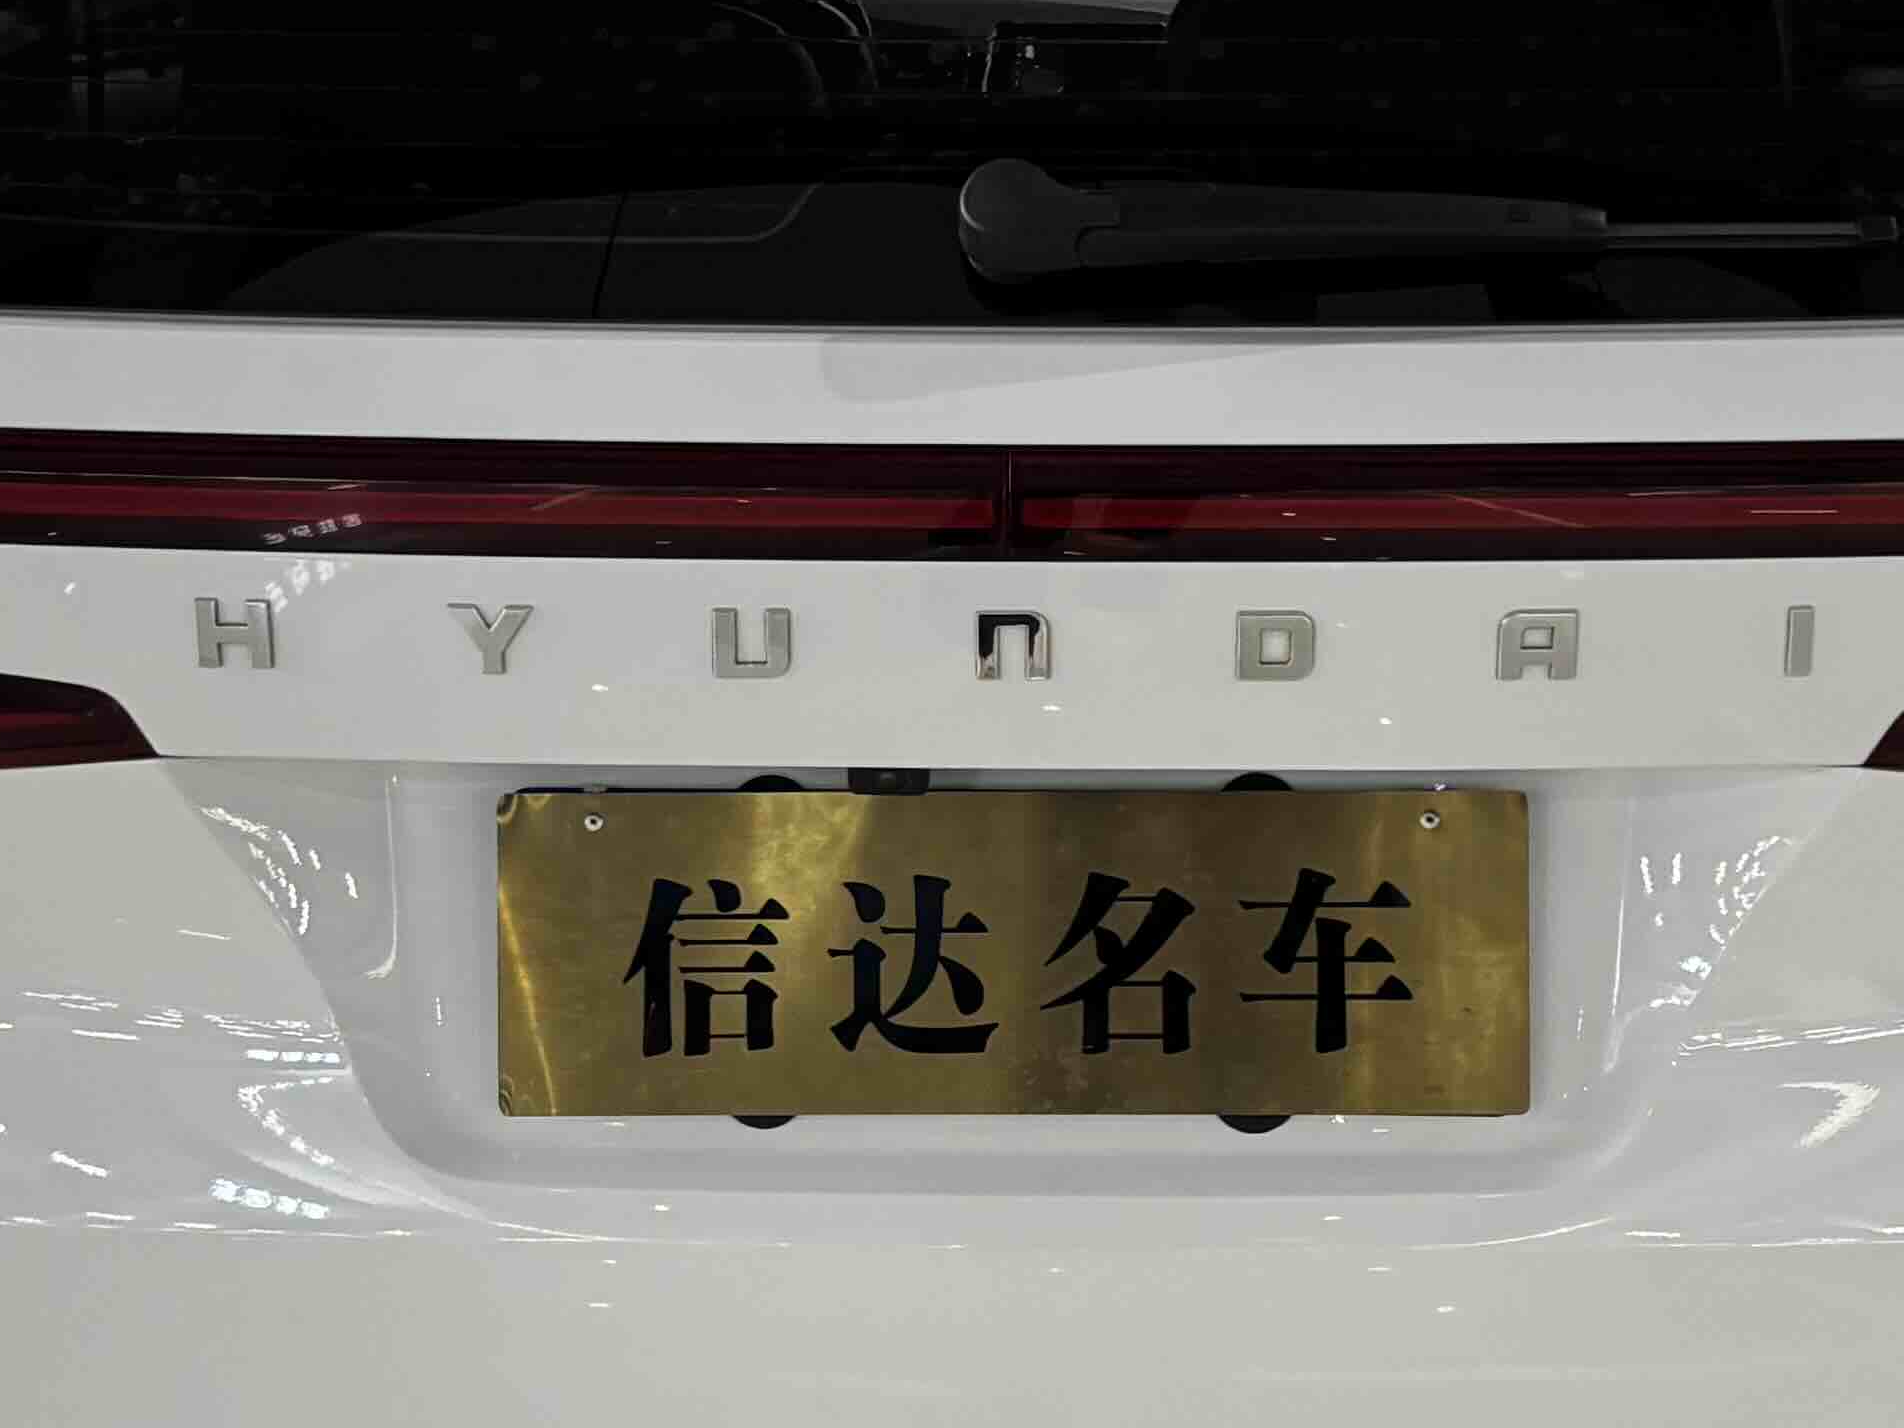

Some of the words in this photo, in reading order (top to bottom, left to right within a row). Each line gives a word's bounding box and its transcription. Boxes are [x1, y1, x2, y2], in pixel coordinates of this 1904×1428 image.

[194, 596, 1816, 682] HYUNDAI
[623, 868, 1414, 1060] 信达名车
